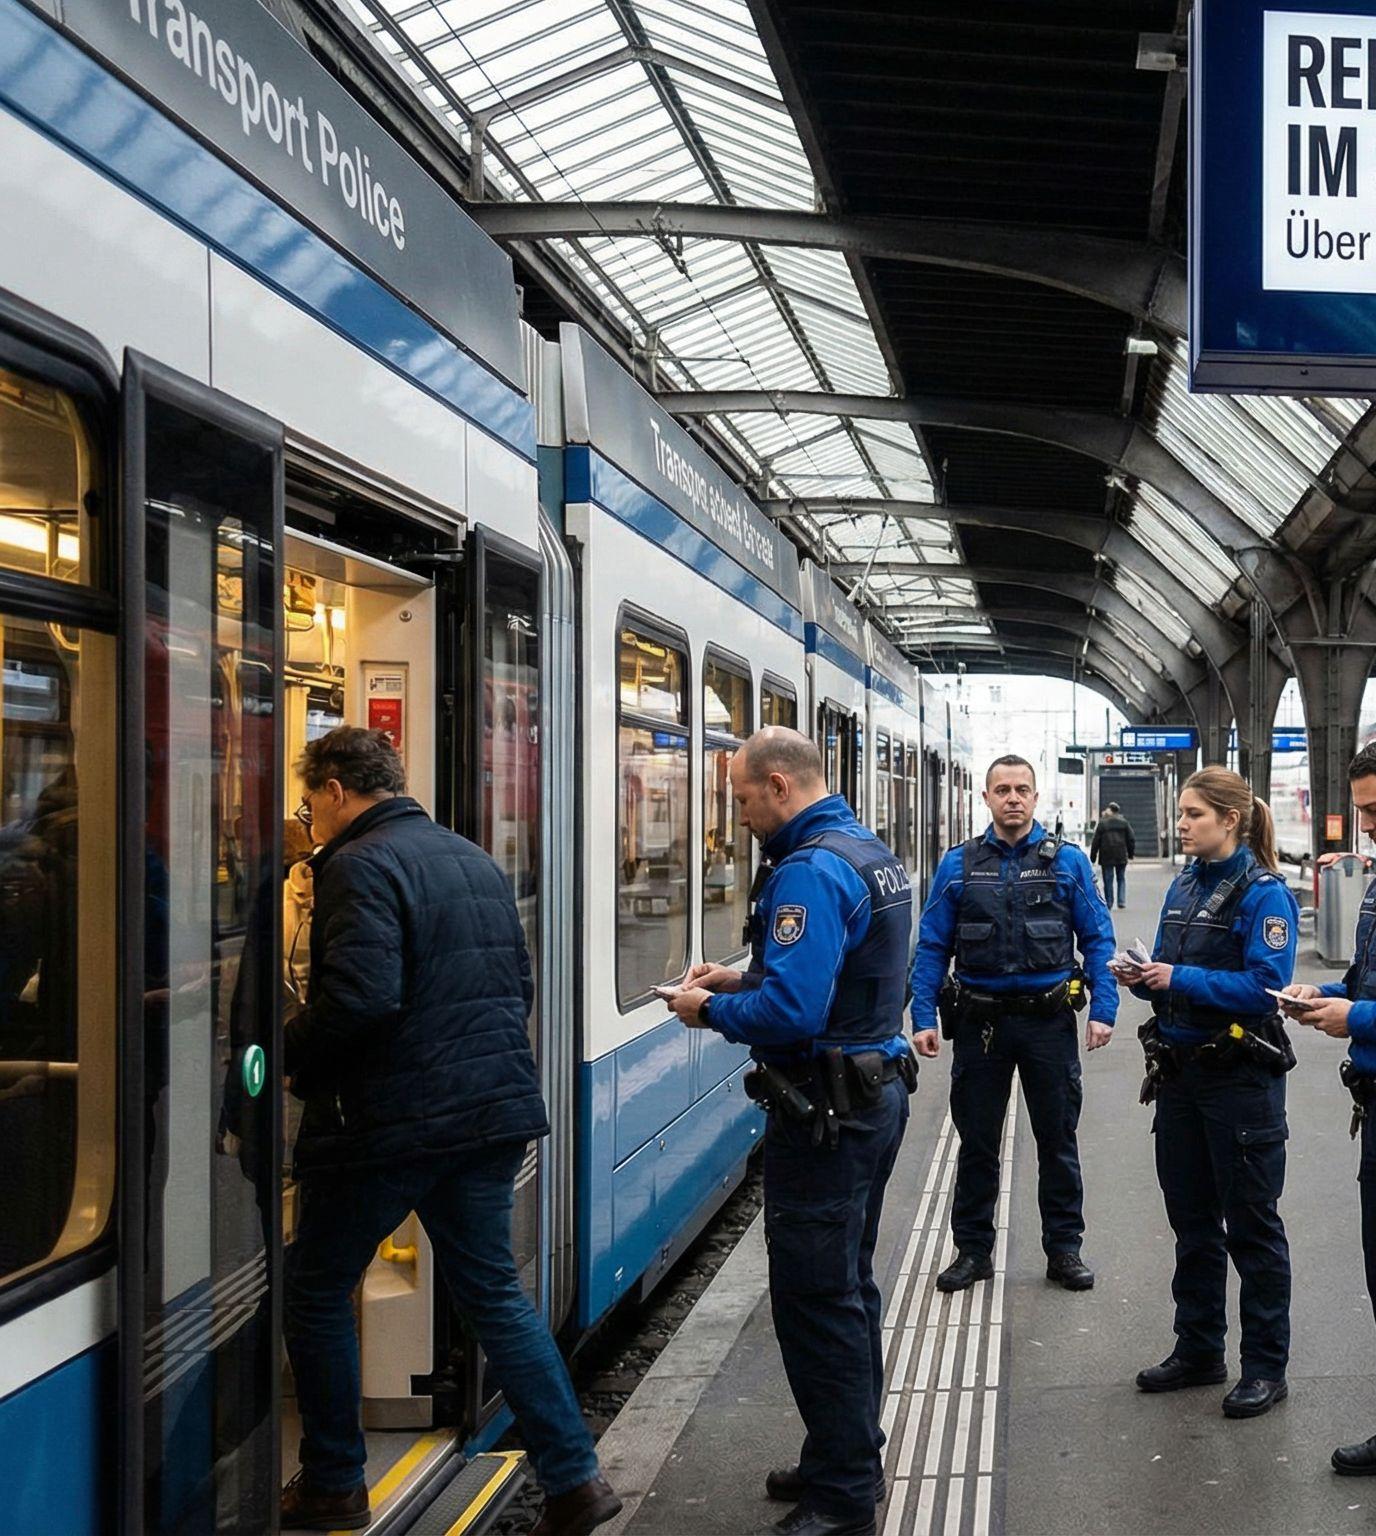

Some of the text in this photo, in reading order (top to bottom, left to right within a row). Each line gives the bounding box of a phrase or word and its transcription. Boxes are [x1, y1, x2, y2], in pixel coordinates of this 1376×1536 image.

[317, 110, 405, 250] Police
[1287, 124, 1358, 198] IM
[1286, 209, 1371, 261] Über
